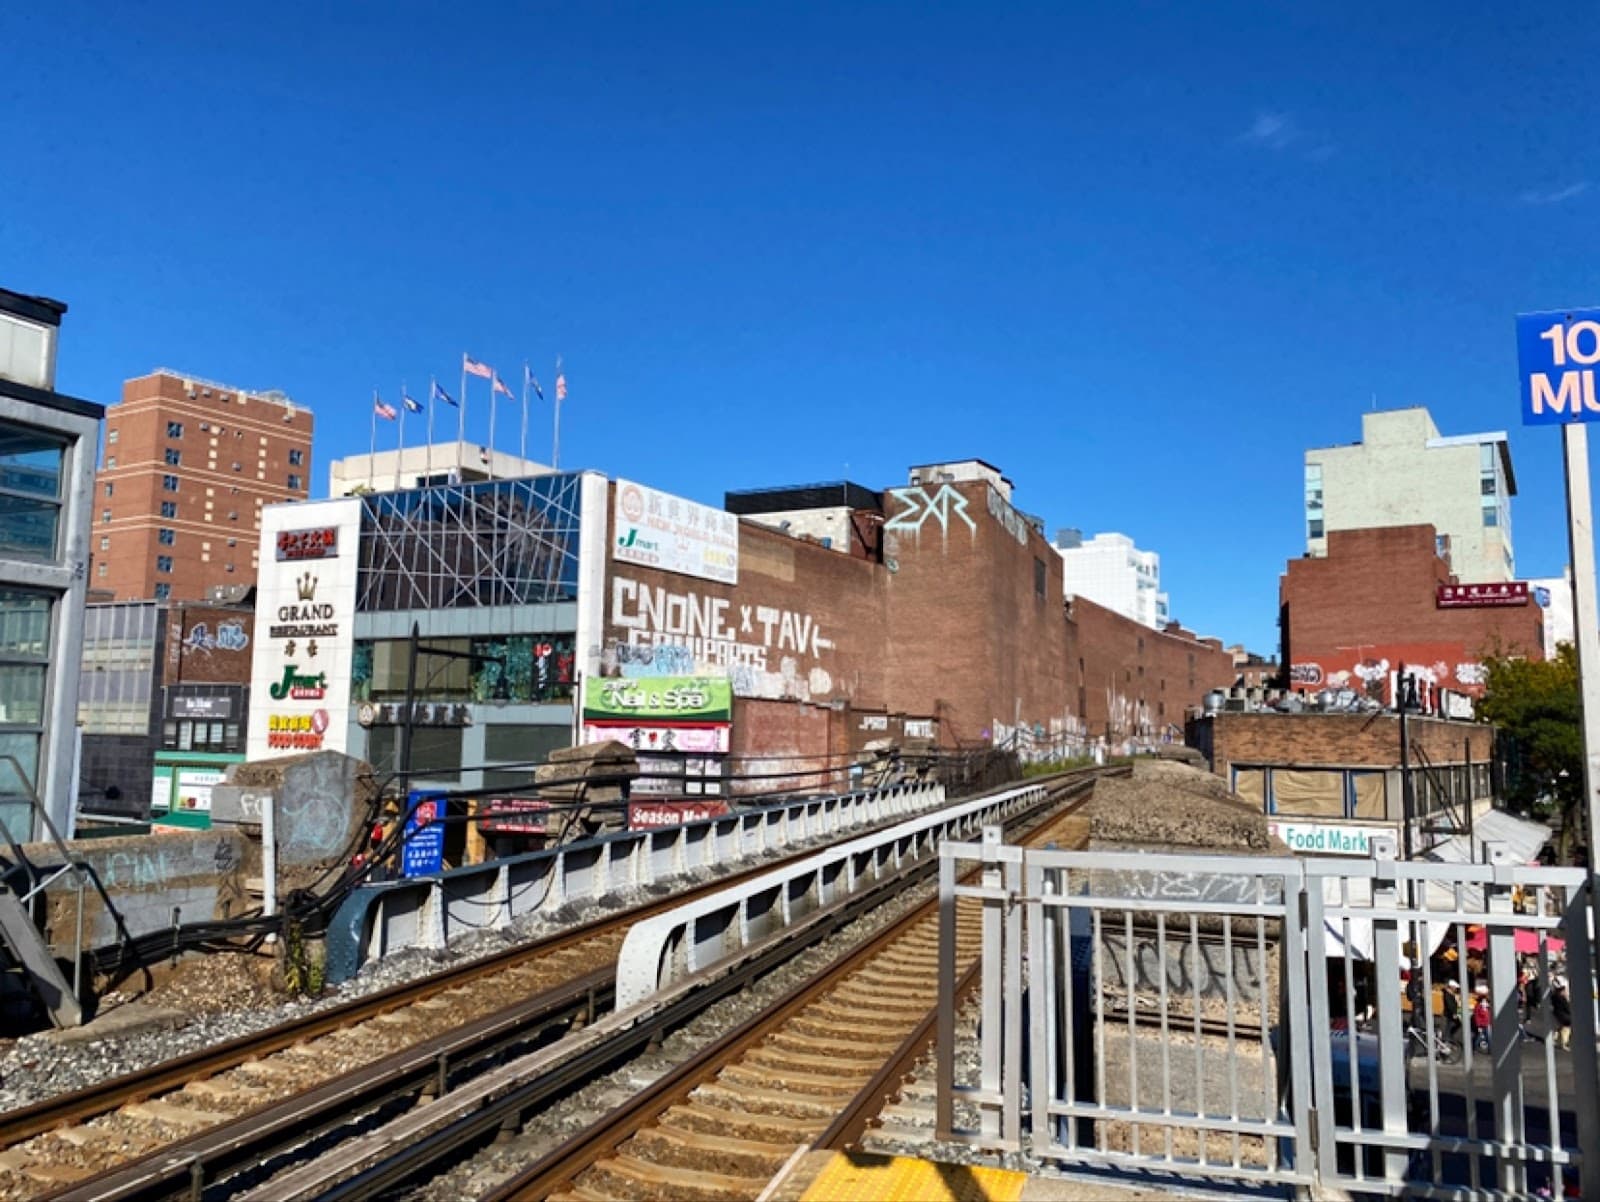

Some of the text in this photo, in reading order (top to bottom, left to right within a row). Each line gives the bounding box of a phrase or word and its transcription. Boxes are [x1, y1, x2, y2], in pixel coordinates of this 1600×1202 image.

[278, 604, 334, 622] GRAND
[663, 687, 706, 711] Spa
[632, 807, 680, 825] Season
[1286, 827, 1325, 849] Food
